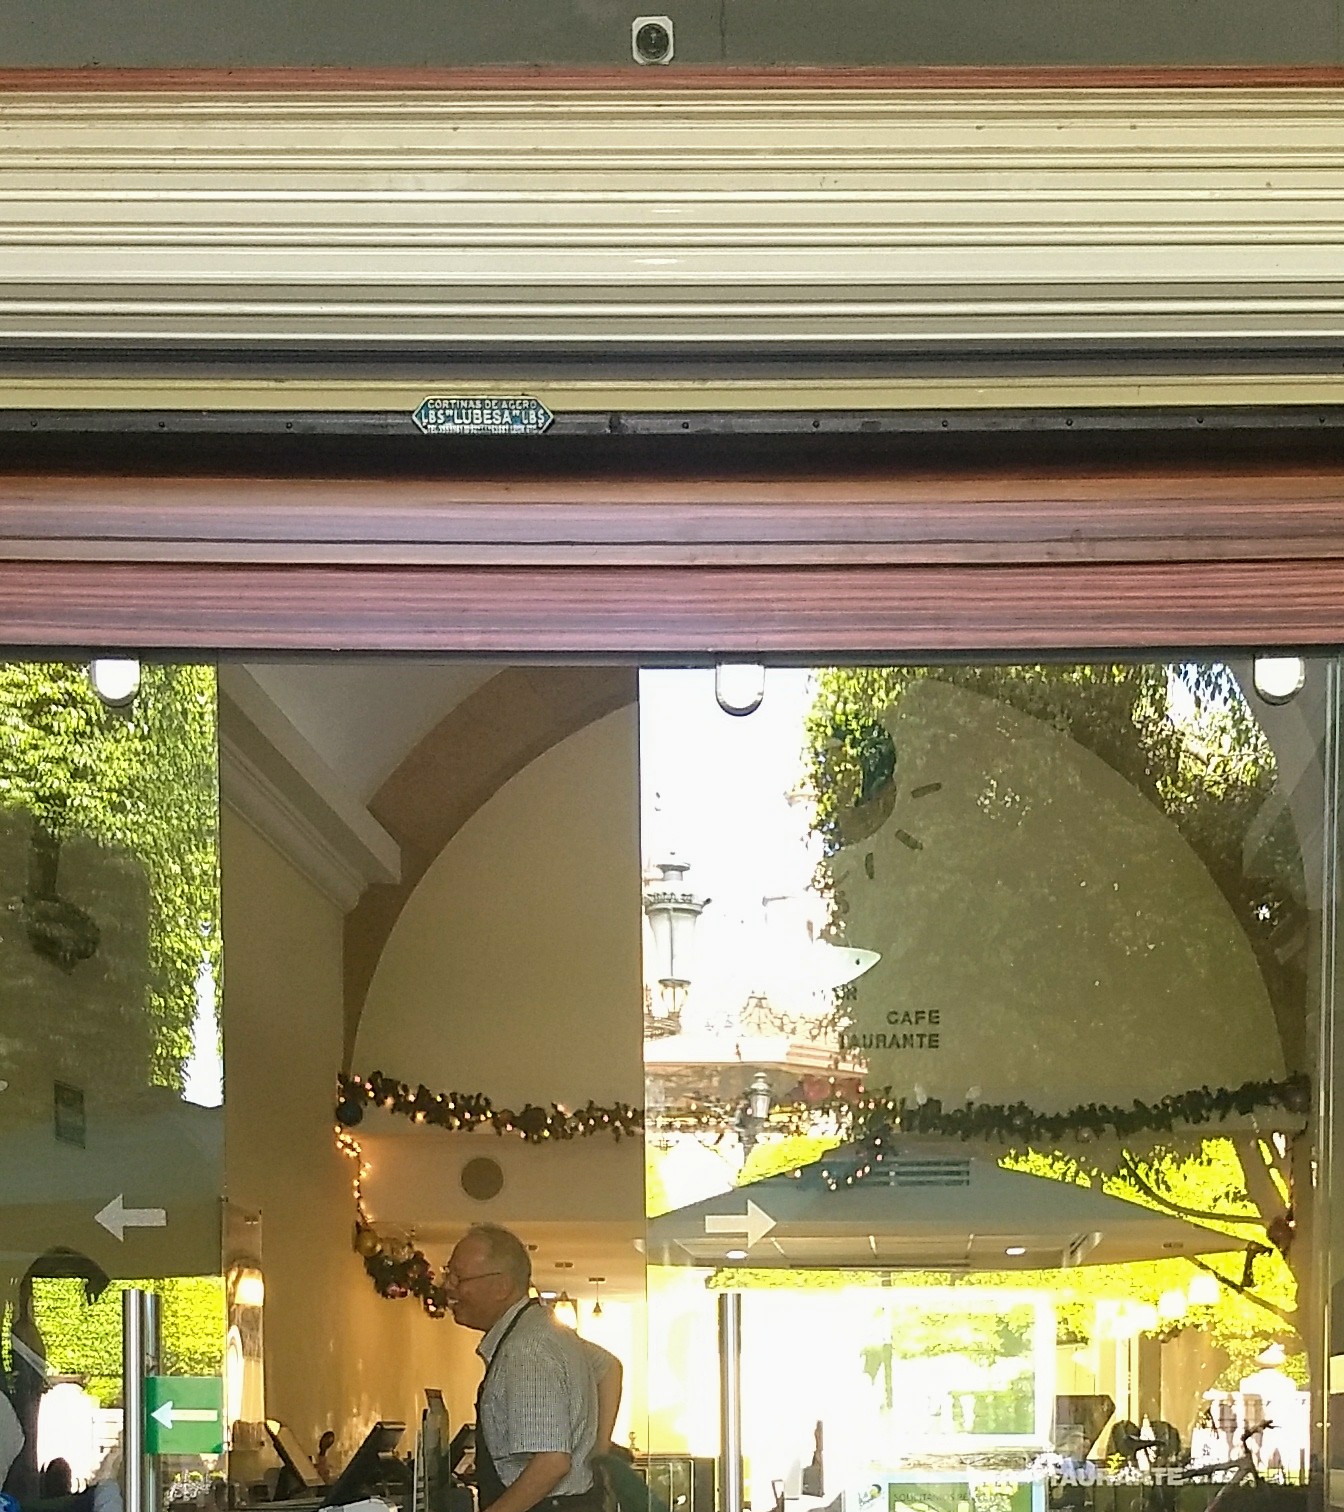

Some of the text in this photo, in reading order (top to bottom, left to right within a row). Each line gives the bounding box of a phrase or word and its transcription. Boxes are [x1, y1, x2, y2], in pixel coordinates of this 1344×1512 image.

[428, 400, 481, 409] CORTINAS
[485, 400, 498, 409] DE
[886, 1010, 940, 1025] CAFE
